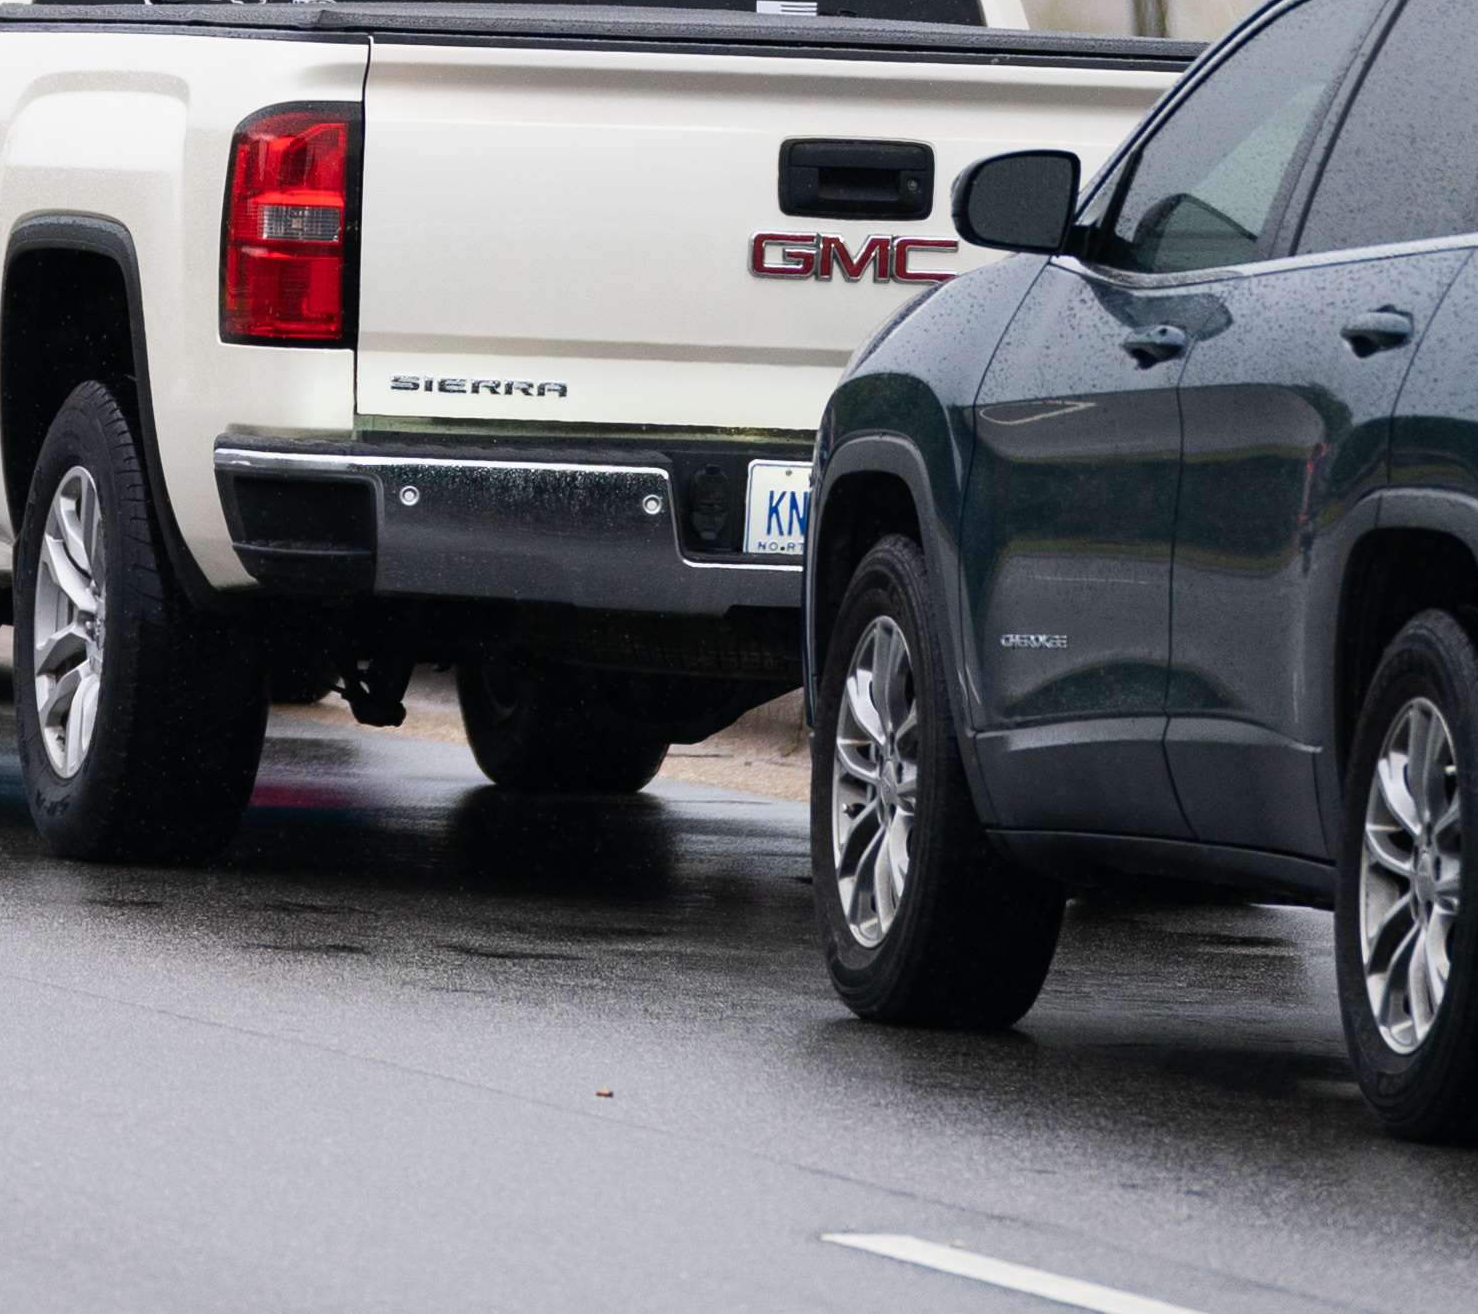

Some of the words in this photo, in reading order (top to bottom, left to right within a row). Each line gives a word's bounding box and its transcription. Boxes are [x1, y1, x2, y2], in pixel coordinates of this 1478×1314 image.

[748, 231, 959, 283] GMC
[390, 375, 568, 398] SIERRA
[1000, 634, 1067, 648] CHEROKEE
